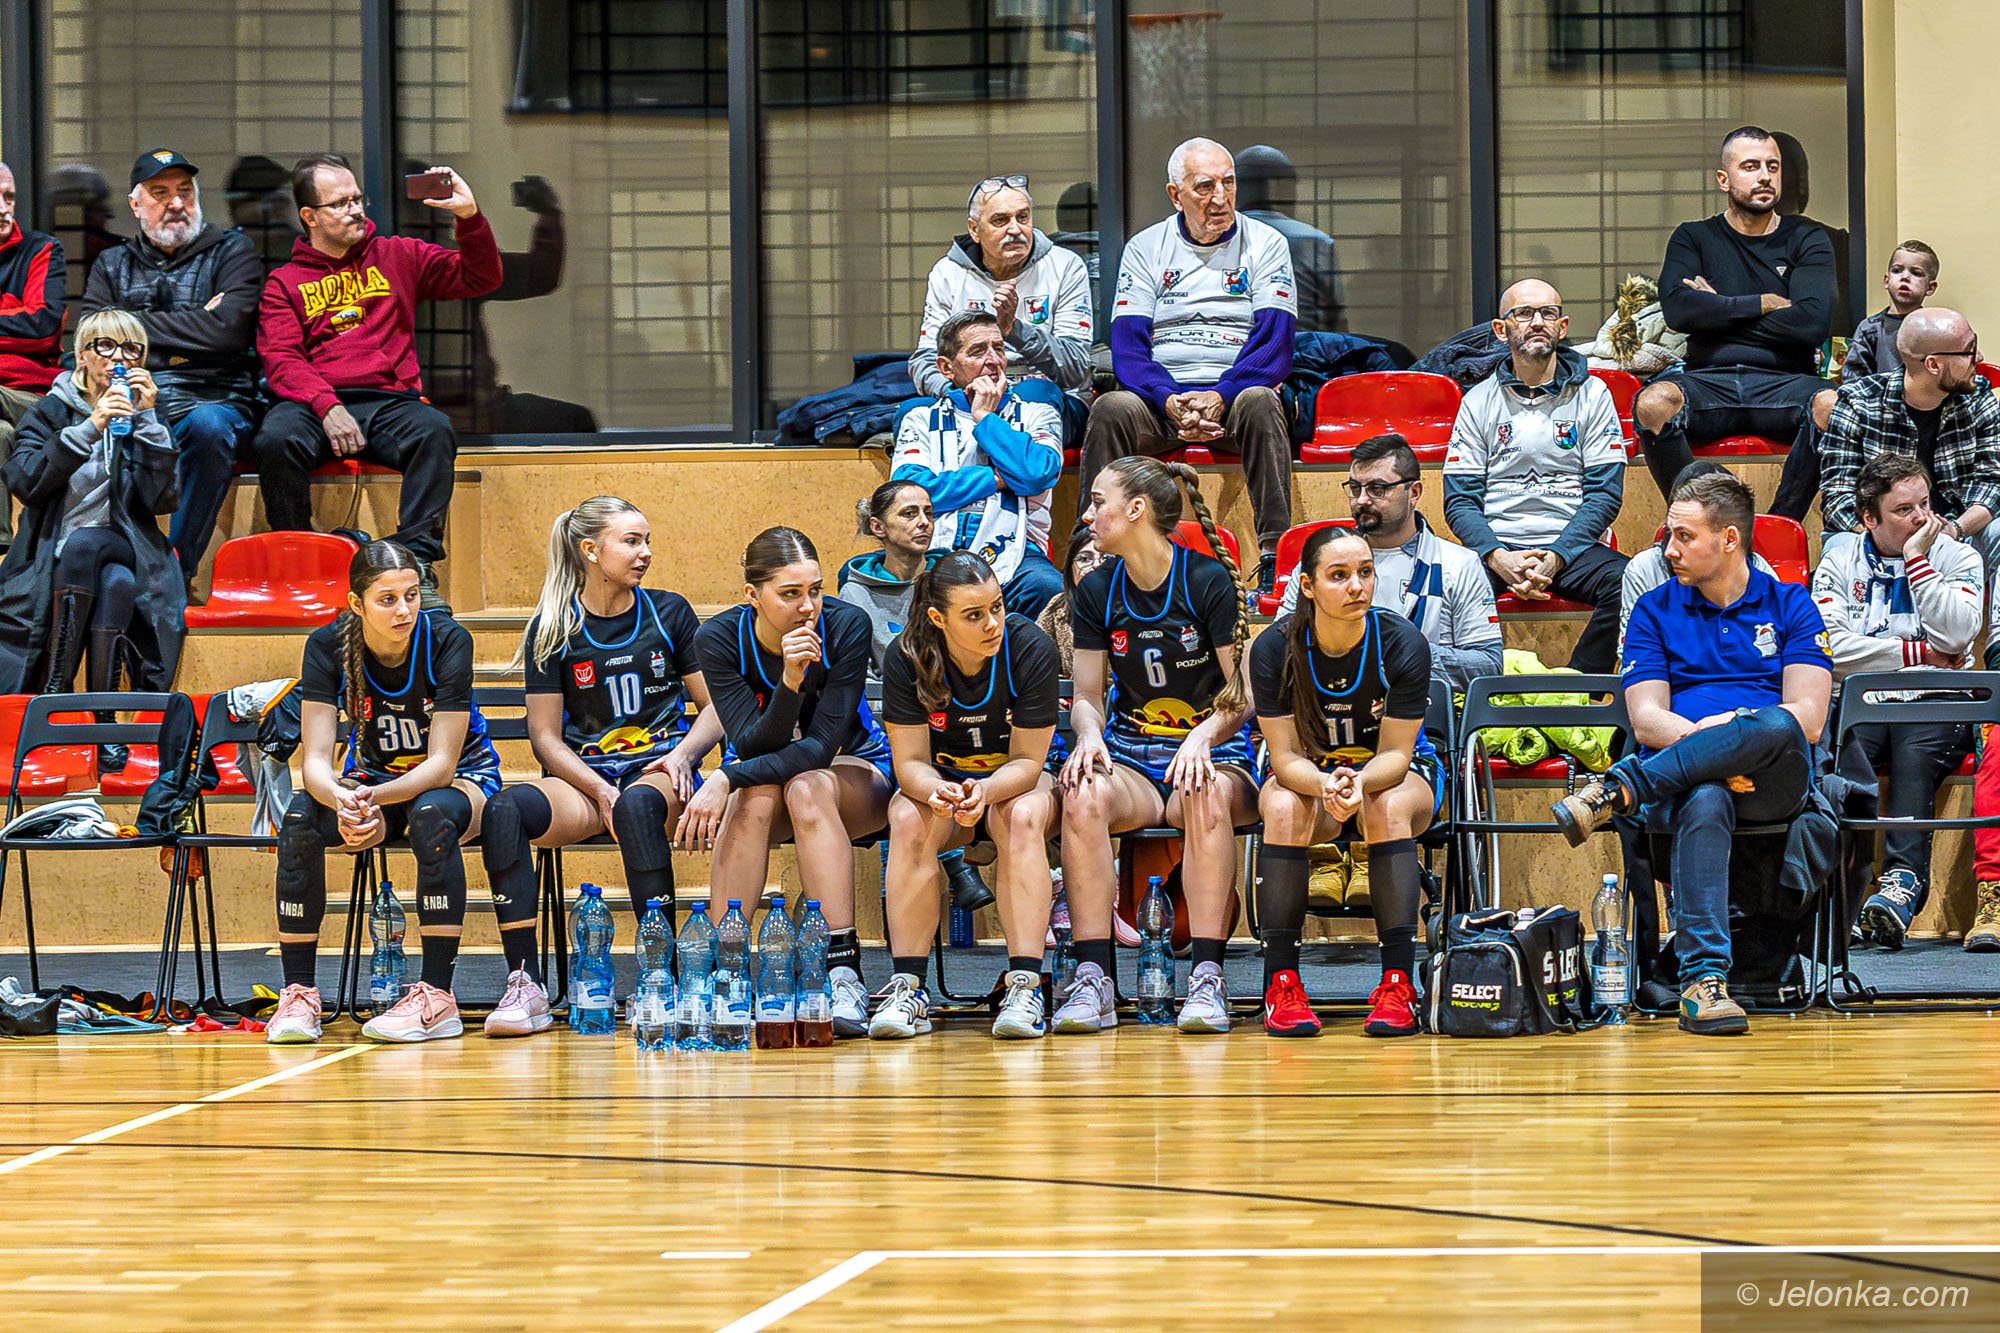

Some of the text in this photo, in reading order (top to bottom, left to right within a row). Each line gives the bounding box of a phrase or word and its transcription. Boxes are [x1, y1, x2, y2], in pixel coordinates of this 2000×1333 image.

[297, 265, 391, 317] ROMA
[1143, 648, 1168, 688] 6
[604, 673, 641, 718] 10
[377, 715, 422, 752] 30
[967, 727, 983, 748] 1
[1324, 717, 1355, 746] 11
[286, 902, 304, 918] NBA
[430, 896, 448, 910] NBA
[1451, 983, 1502, 1001] SELECT
